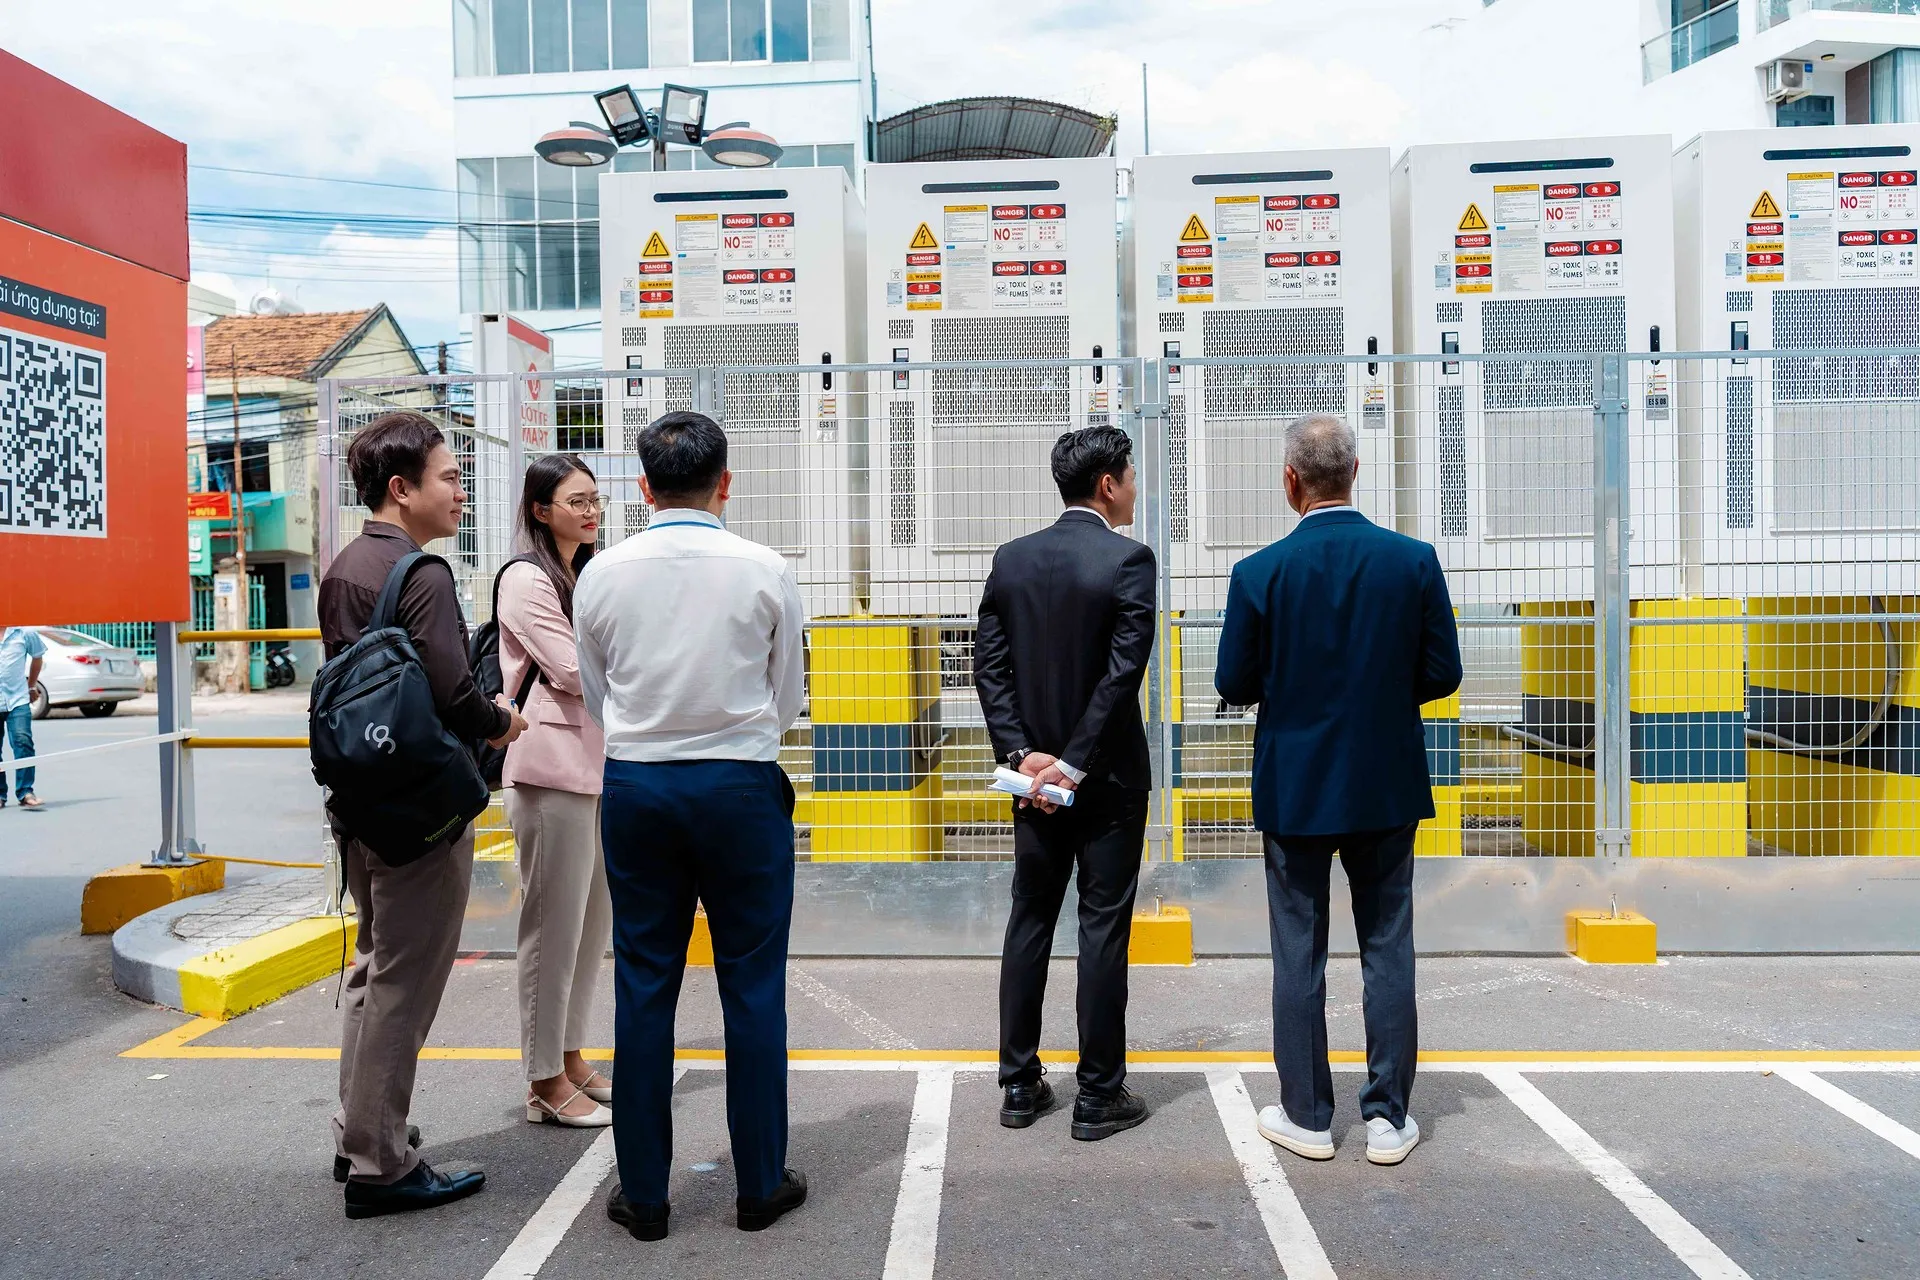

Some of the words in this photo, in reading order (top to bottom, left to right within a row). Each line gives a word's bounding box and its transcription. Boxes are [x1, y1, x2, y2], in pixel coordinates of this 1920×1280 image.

[1840, 196, 1857, 209] NO
[1546, 207, 1563, 220] NO
[1266, 219, 1283, 231] NO
[994, 228, 1010, 240] NO
[724, 236, 740, 248] NO
[12, 285, 39, 315] ứng
[43, 296, 76, 325] dụng
[80, 307, 99, 329] tại:
[521, 405, 547, 426] LOTTE
[522, 427, 548, 449] MART
